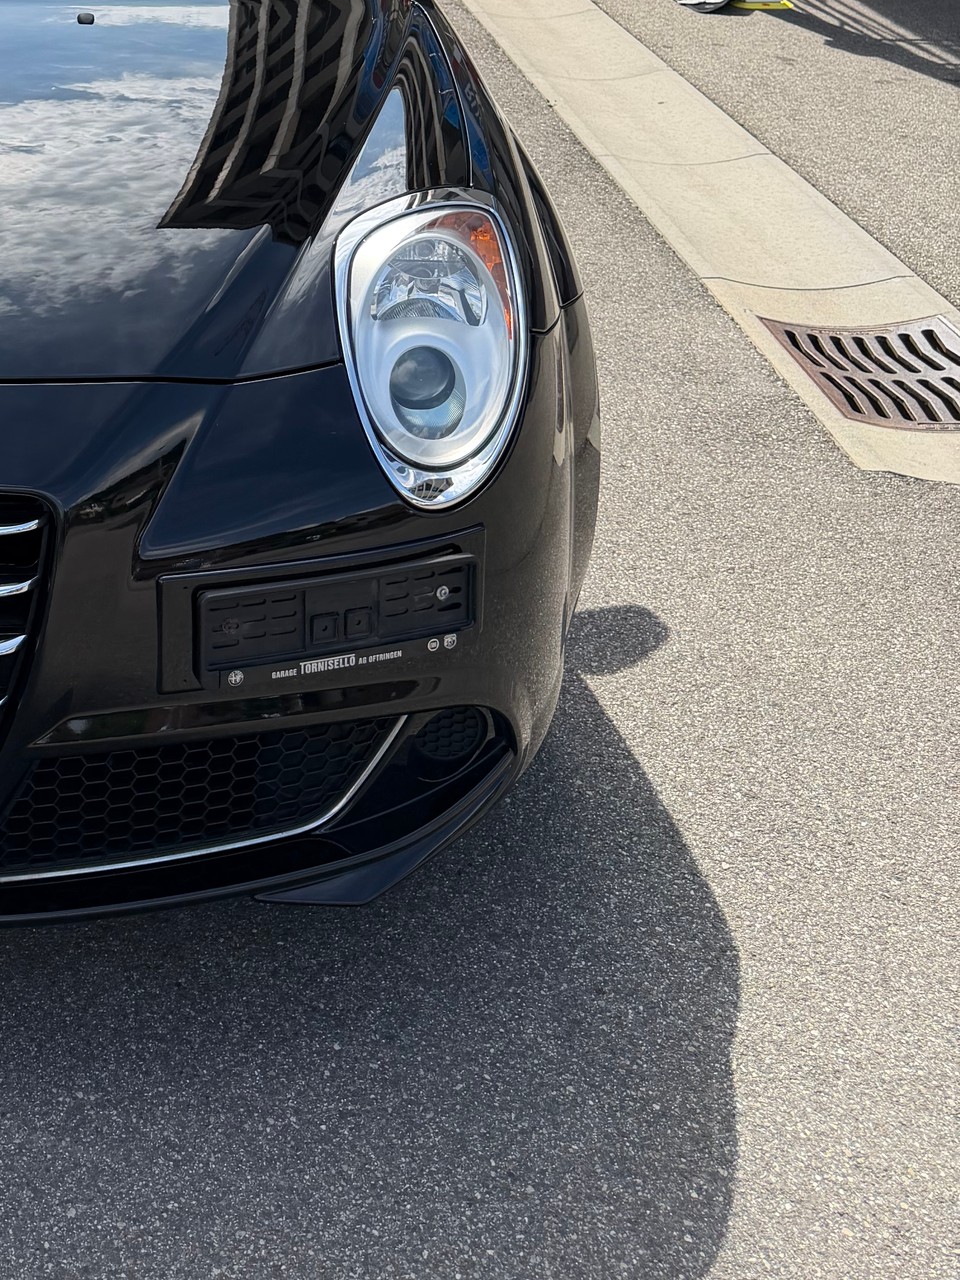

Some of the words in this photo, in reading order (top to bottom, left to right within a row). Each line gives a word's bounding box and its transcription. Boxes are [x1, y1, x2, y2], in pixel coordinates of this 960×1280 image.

[271, 668, 298, 679] GARAGE
[299, 653, 356, 674] TORNISELLO
[358, 657, 367, 665] AG
[368, 650, 402, 663] OFTRINGEN
